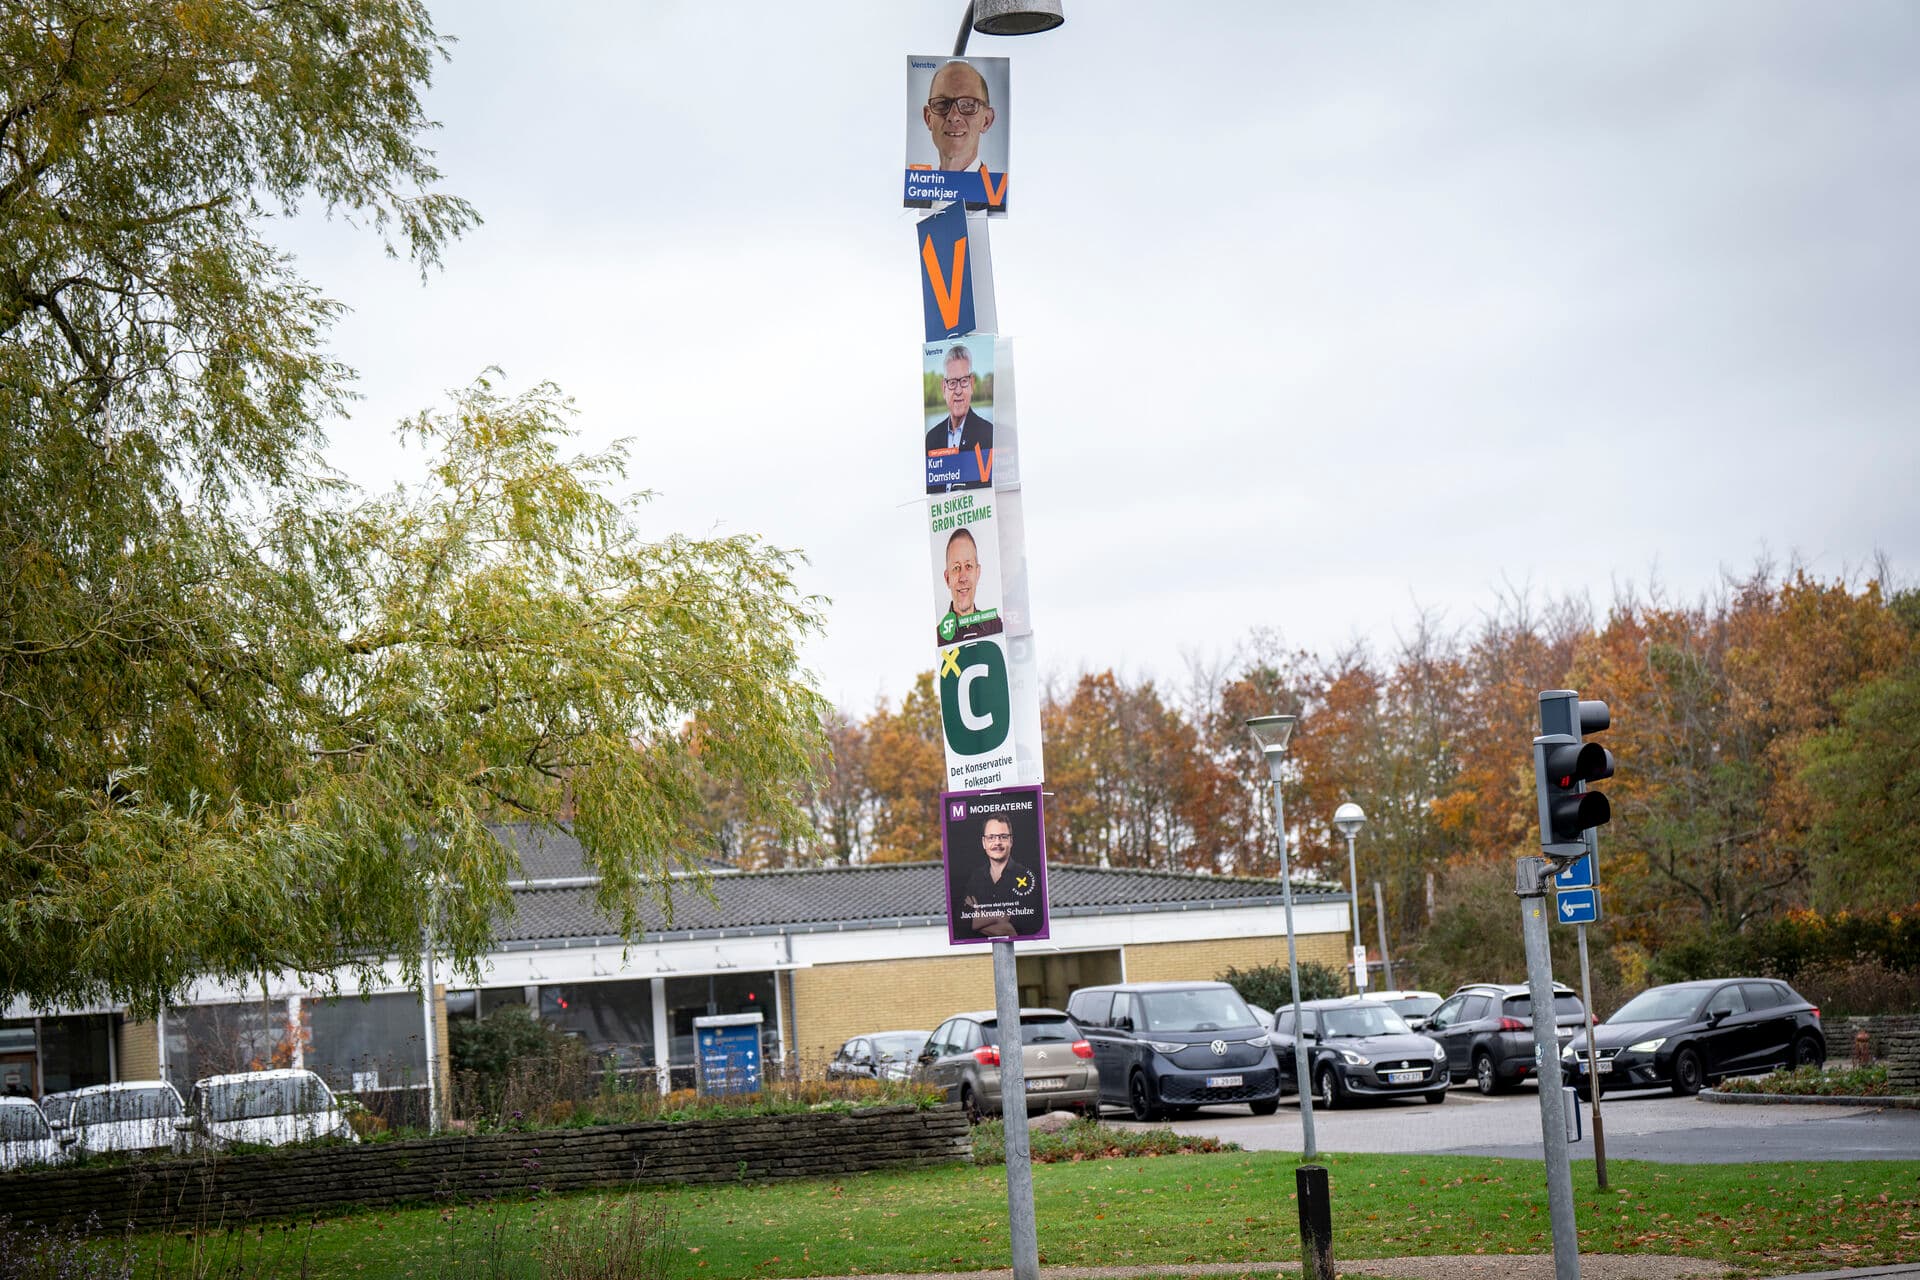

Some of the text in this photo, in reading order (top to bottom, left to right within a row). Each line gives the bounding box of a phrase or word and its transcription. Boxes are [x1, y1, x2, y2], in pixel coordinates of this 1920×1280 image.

[911, 61, 936, 69] Venstre
[909, 172, 945, 184] Martin
[980, 164, 1008, 206] V
[908, 186, 959, 200] Grønkjær
[922, 232, 968, 331] V
[925, 348, 943, 356] Venstre
[927, 458, 943, 469] Kurt
[974, 442, 993, 483] V
[928, 468, 961, 483] Damsted
[930, 494, 974, 518] EN SIKKER
[932, 505, 993, 533] GRØN STEMME
[943, 619, 954, 635] SF
[957, 663, 994, 731] C
[950, 755, 1013, 777] Det Konservative
[964, 771, 1002, 789] Folkeparti
[953, 801, 1033, 817] M MODERATERNE
[960, 907, 1035, 919] Jacob Kronby Schulze
